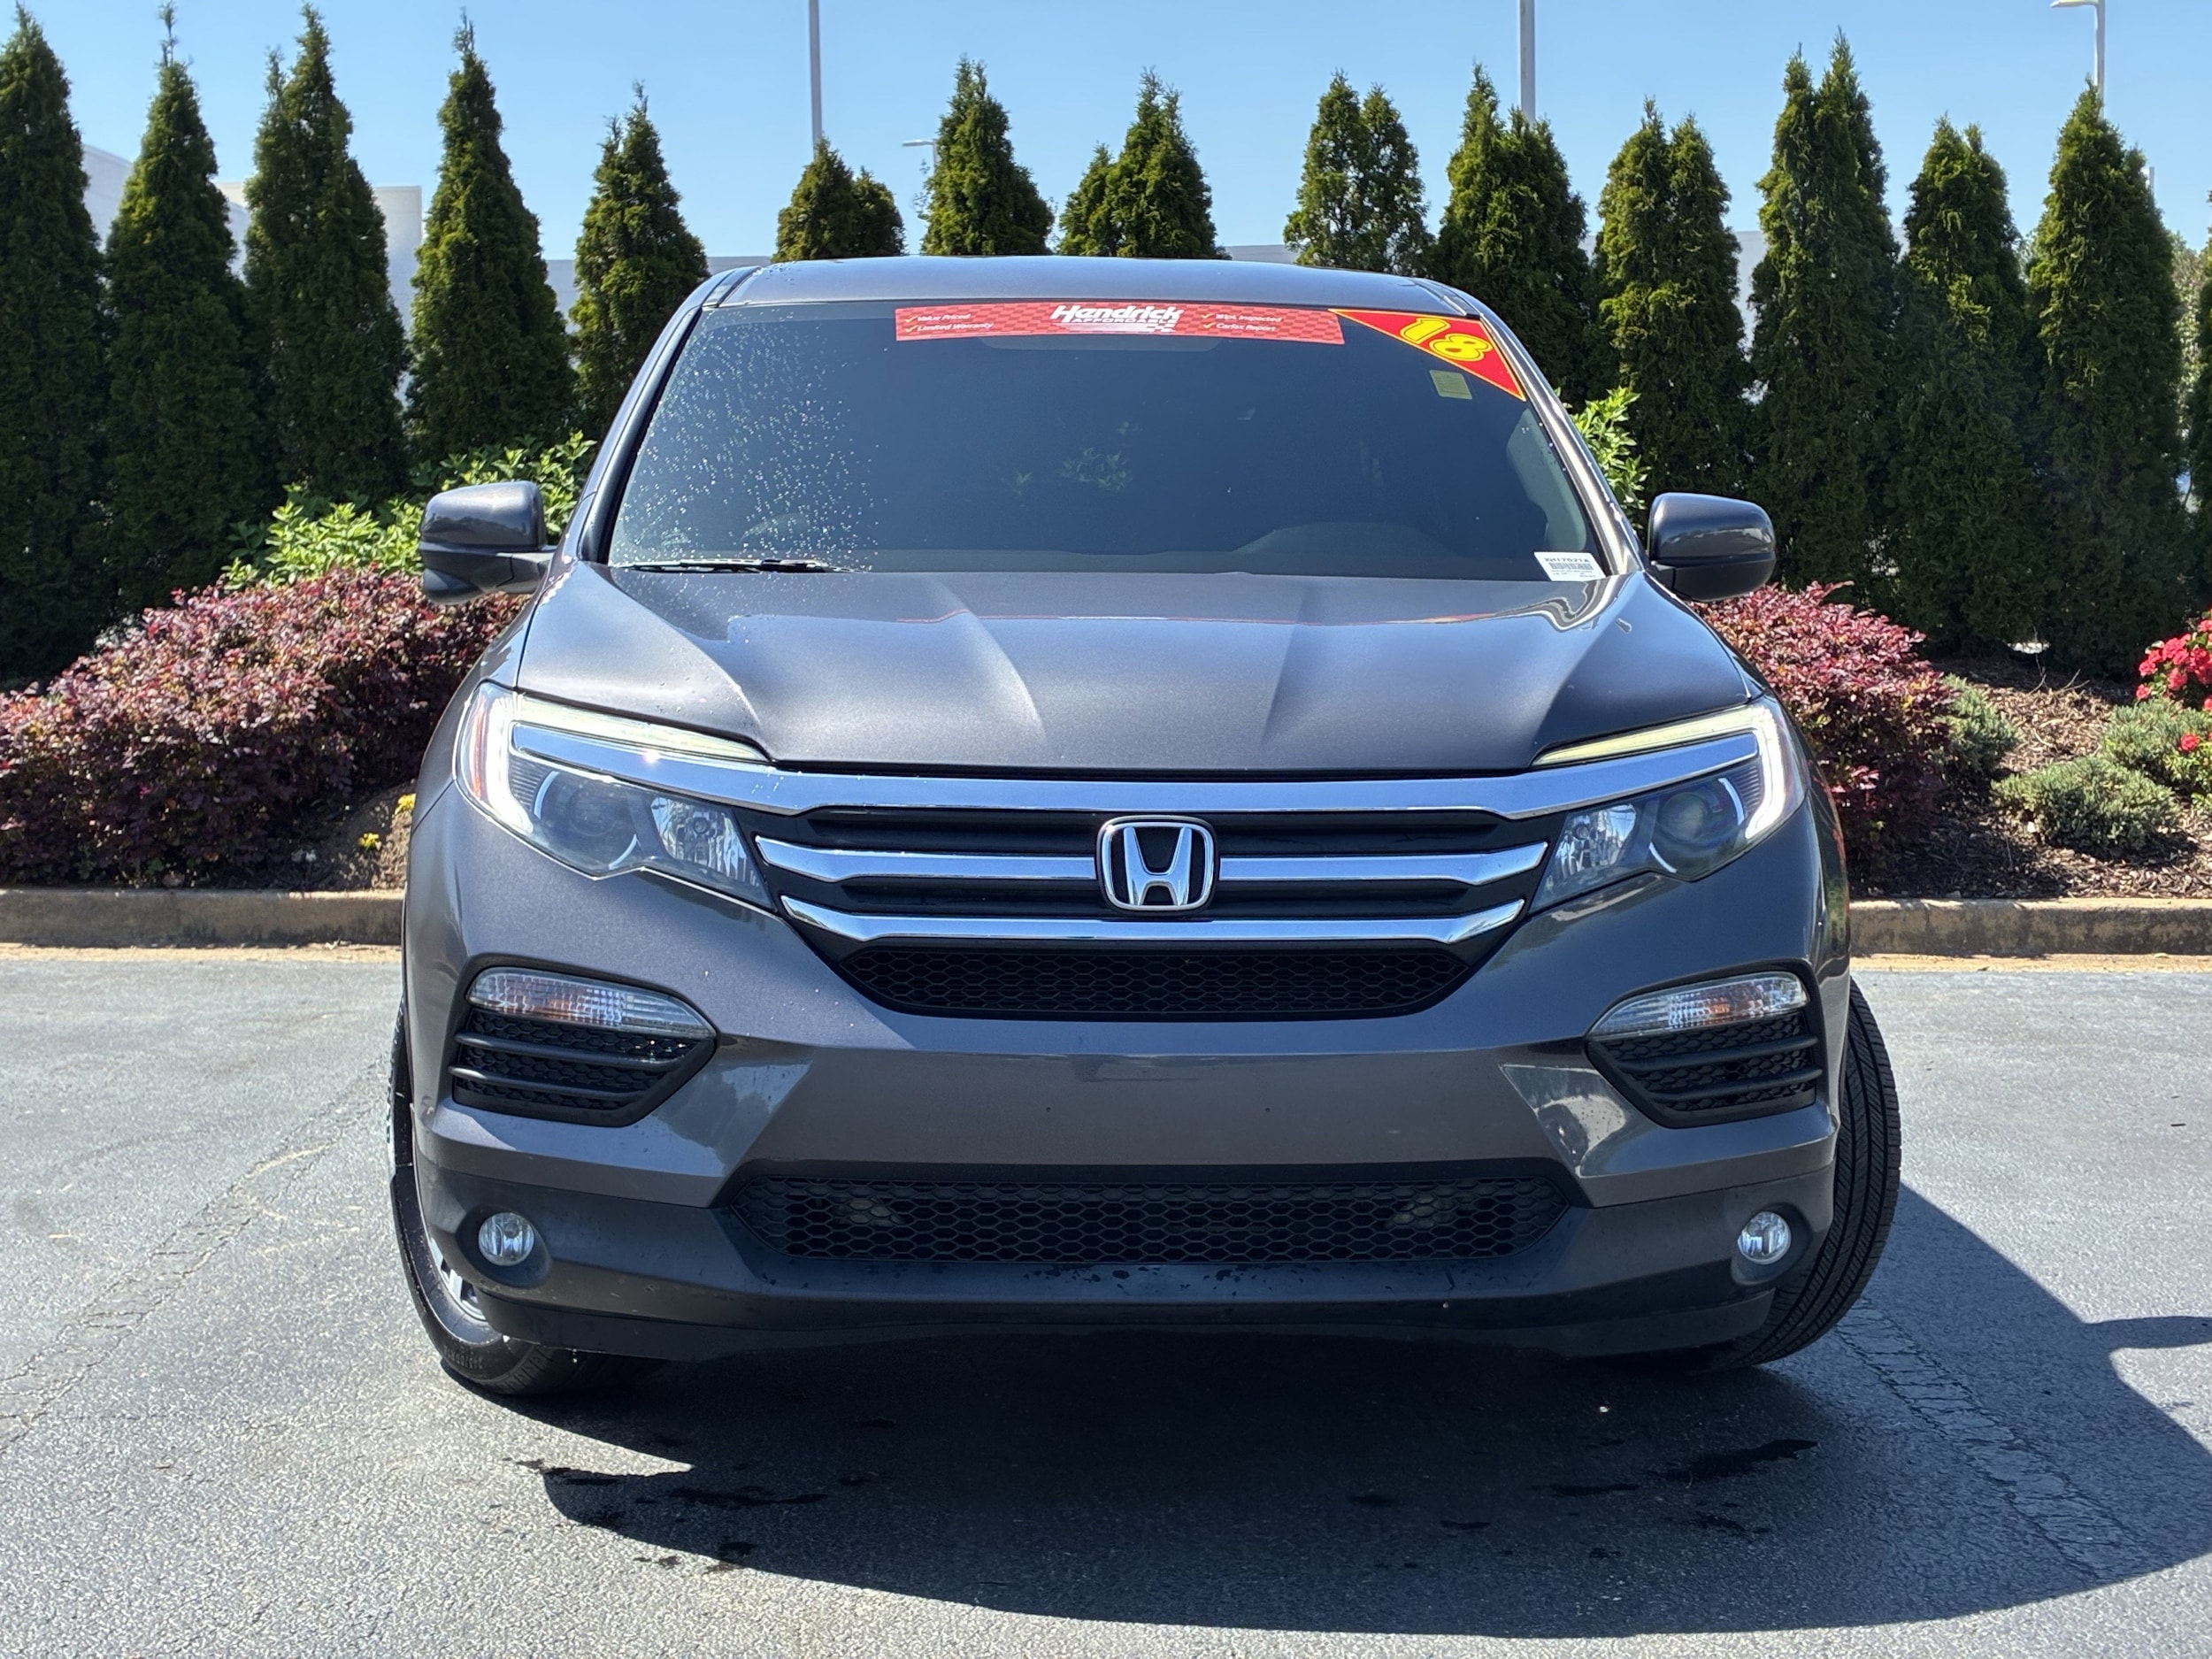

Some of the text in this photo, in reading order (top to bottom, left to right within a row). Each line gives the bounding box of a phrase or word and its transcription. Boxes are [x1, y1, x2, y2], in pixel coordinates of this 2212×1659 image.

[1050, 305, 1184, 322] Hendrick
[918, 323, 951, 332] Limited
[1400, 317, 1493, 361] 18
